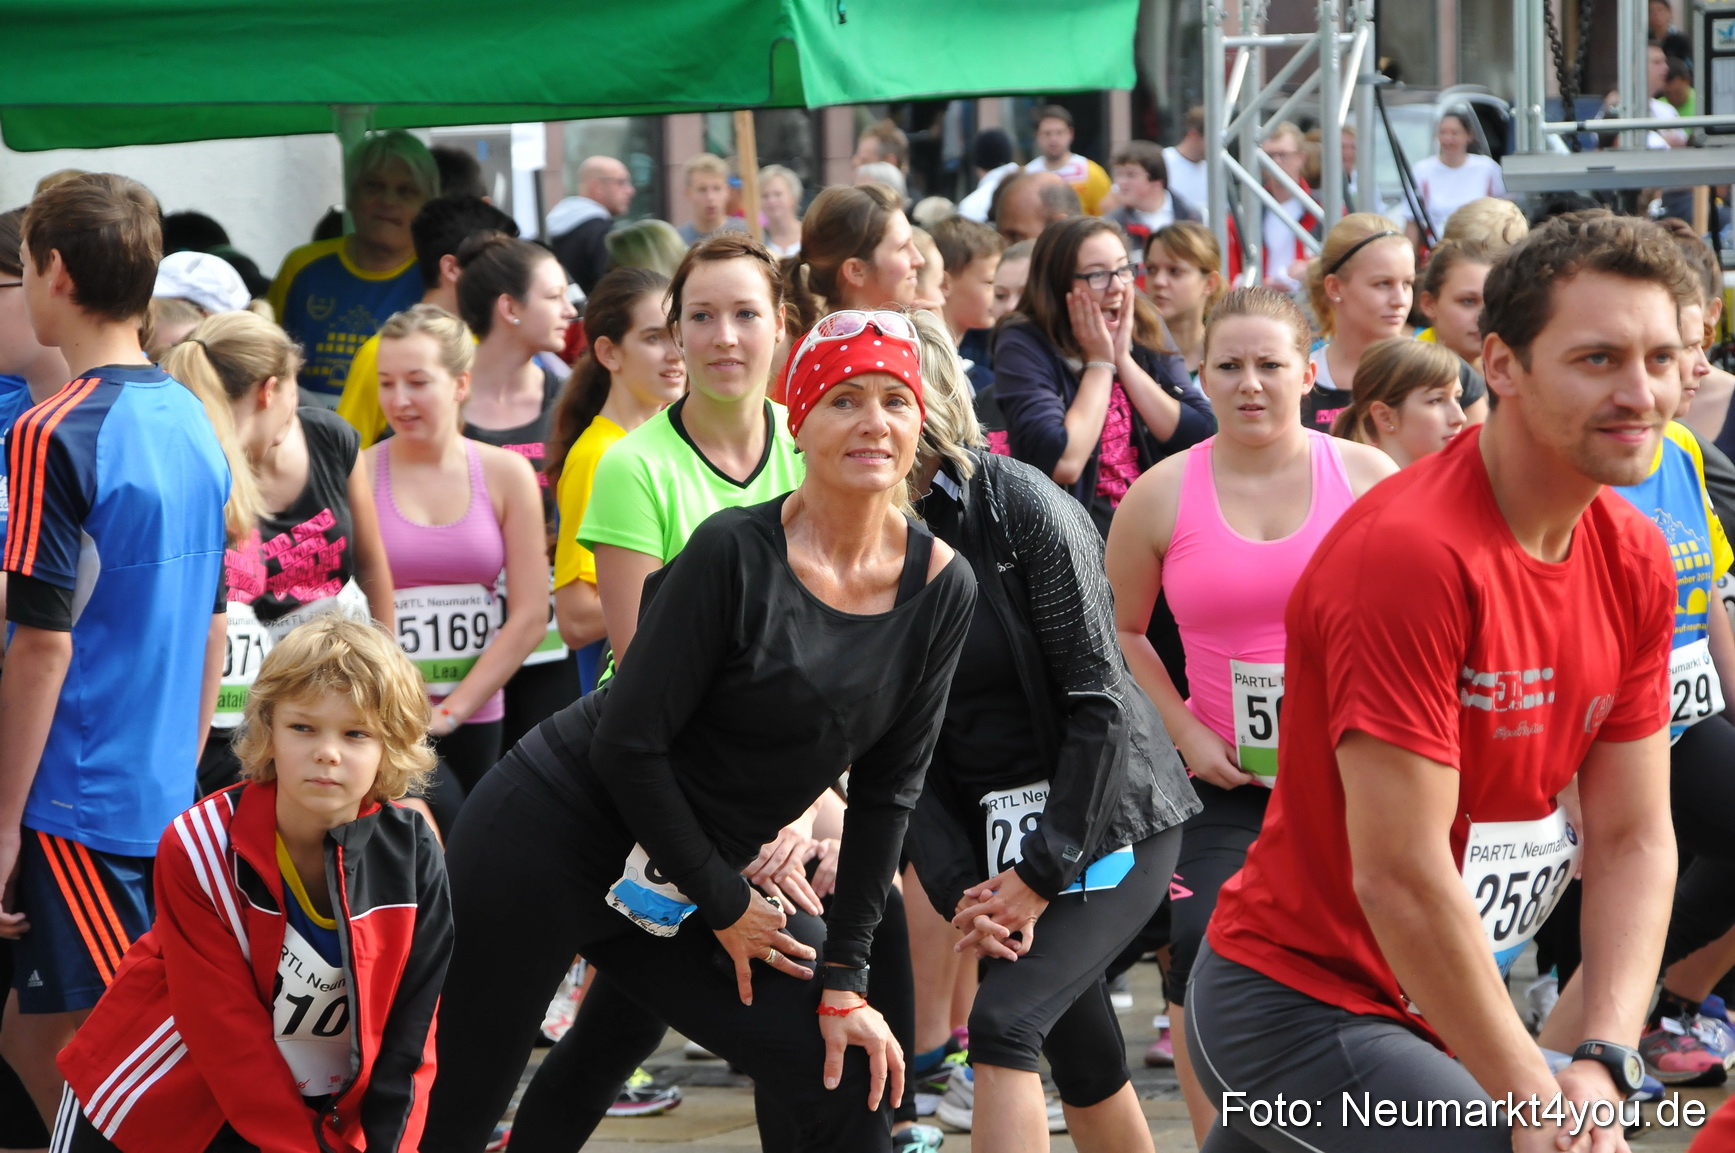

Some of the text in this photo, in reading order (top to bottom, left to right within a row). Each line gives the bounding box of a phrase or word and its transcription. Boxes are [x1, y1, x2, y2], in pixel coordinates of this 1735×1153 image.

[427, 595, 481, 607] Neumarkt
[398, 611, 488, 653] 5169
[433, 663, 458, 680] Lea
[1234, 672, 1277, 688] PARTL
[1671, 673, 1712, 722] 29
[1469, 843, 1518, 863] PARTL
[1475, 858, 1571, 941] 2583
